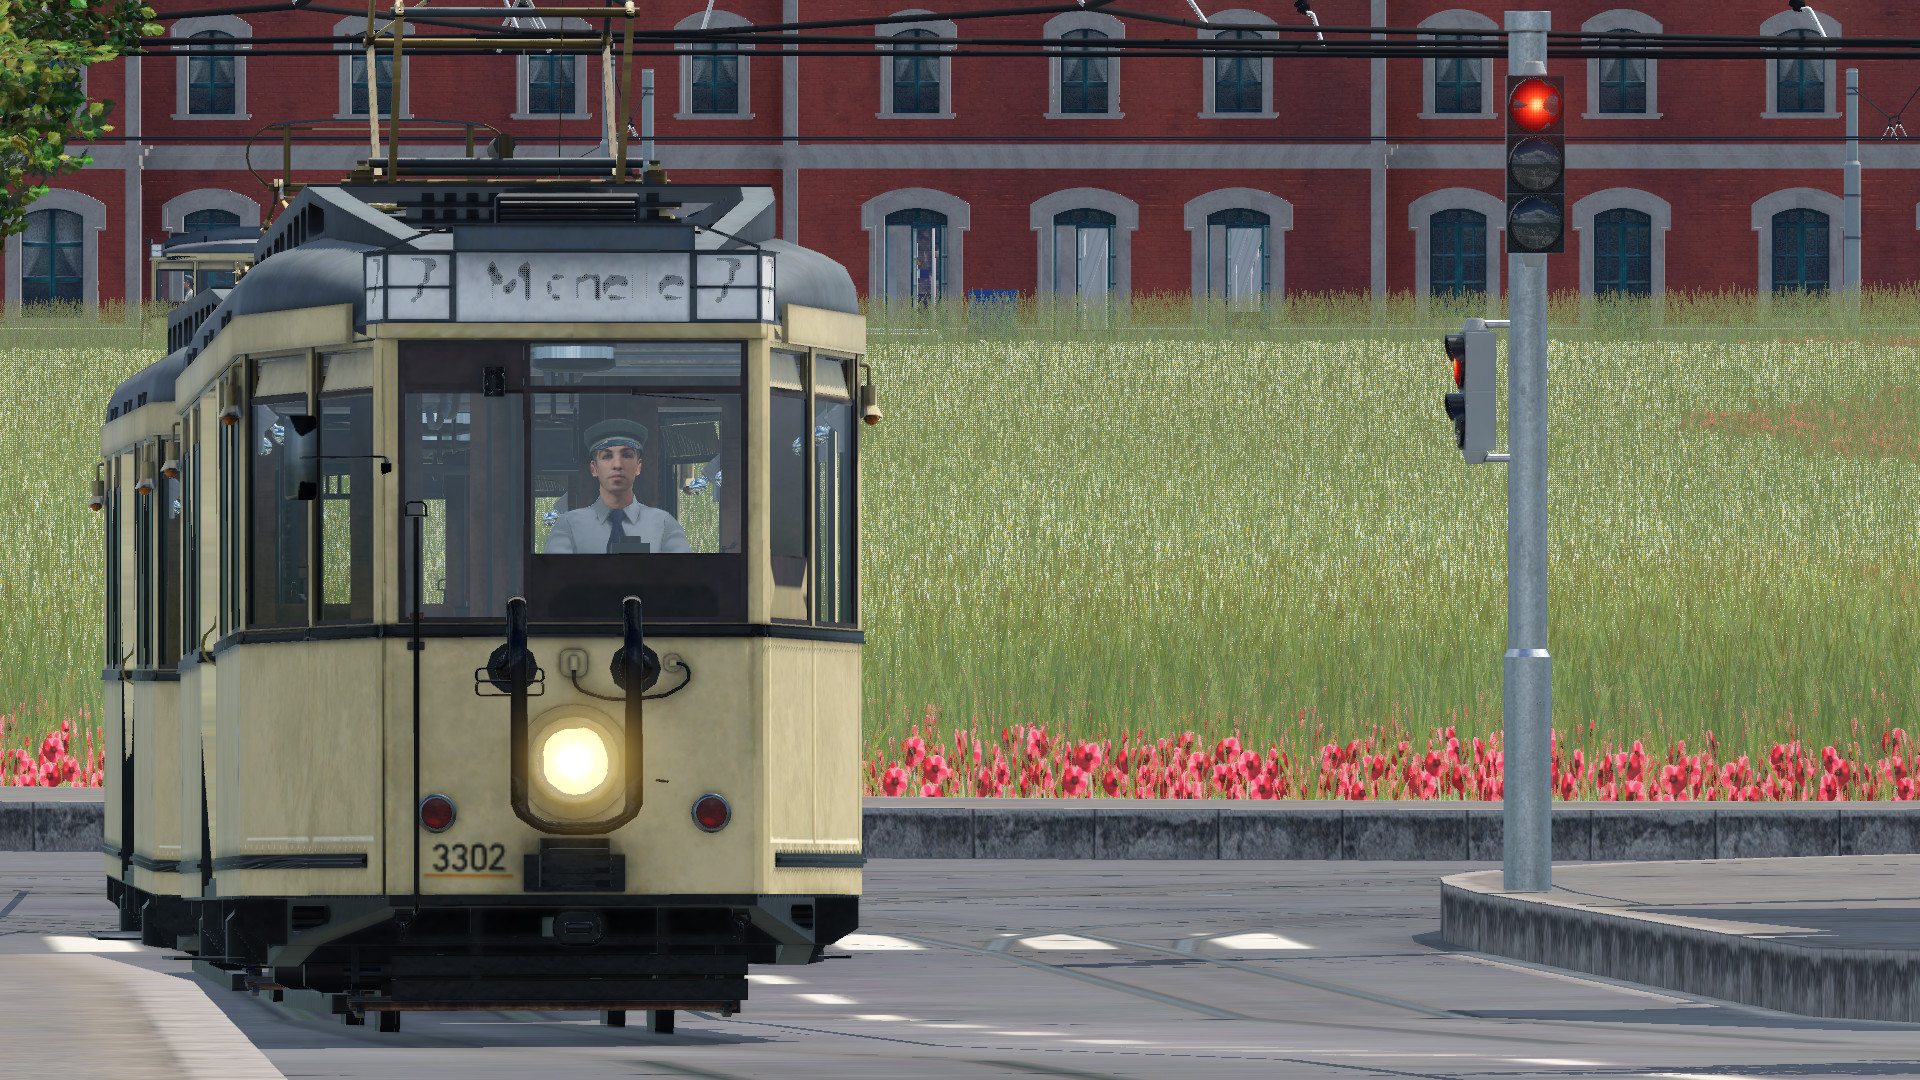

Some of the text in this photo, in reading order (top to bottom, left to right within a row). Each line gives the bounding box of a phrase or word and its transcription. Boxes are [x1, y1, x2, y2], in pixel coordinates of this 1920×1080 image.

[410, 257, 437, 303] 7
[715, 257, 742, 303] 7
[432, 843, 506, 872] 3302
